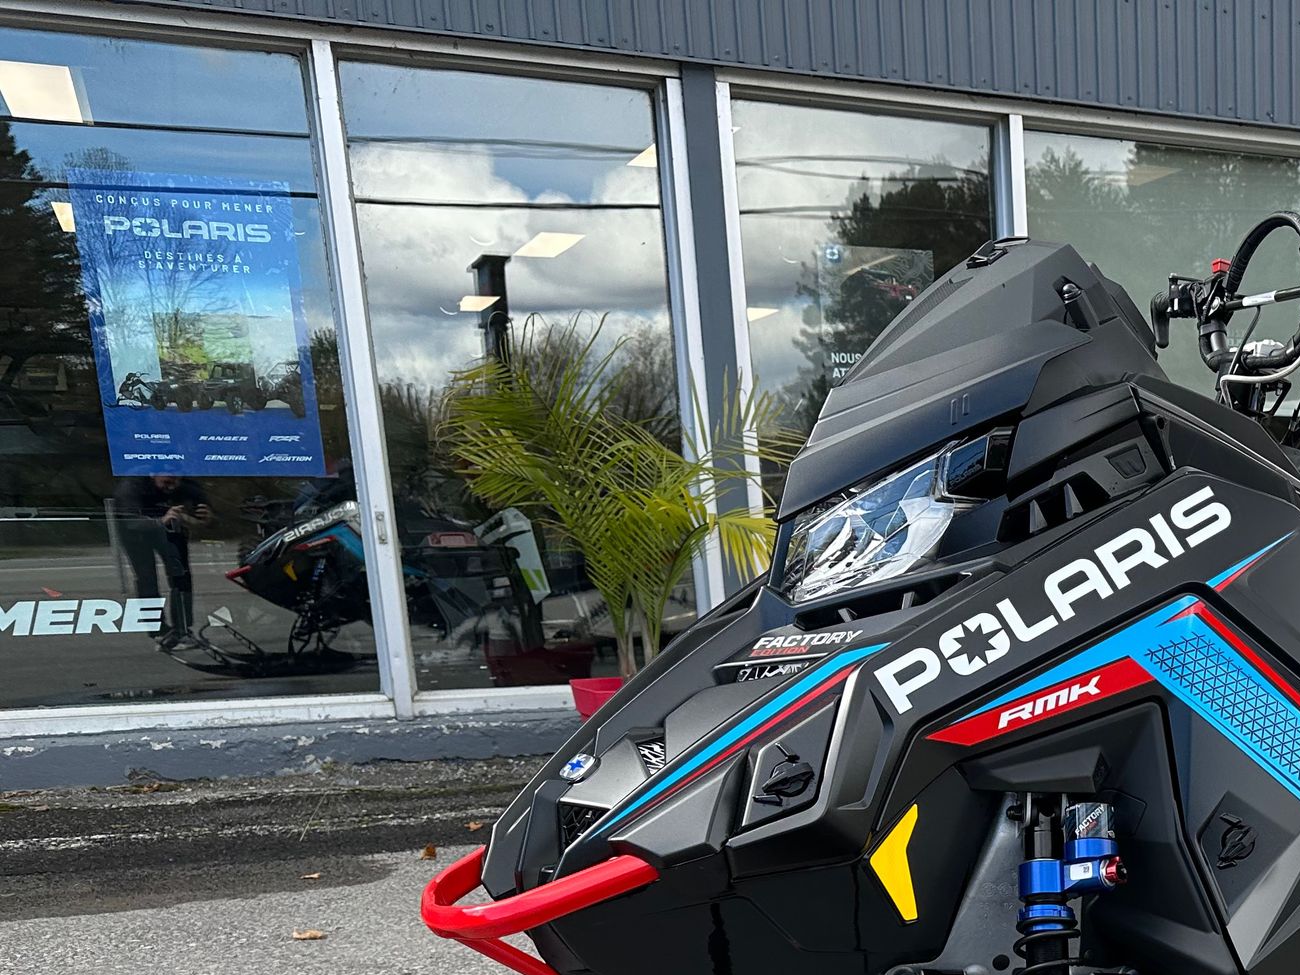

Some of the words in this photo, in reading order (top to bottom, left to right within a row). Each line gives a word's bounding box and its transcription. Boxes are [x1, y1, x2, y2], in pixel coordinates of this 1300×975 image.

[95, 194, 161, 207] CONÇUS
[171, 199, 212, 210] POUR
[221, 202, 273, 213] MENER
[103, 215, 272, 243] POLARIS
[138, 260, 250, 274] S'AVENTURER
[873, 485, 1232, 715] POLARIS
[749, 645, 810, 658] EDITION
[752, 630, 863, 650] FACTORY
[997, 674, 1101, 730] RMK
[1075, 803, 1106, 836] FACTORY
